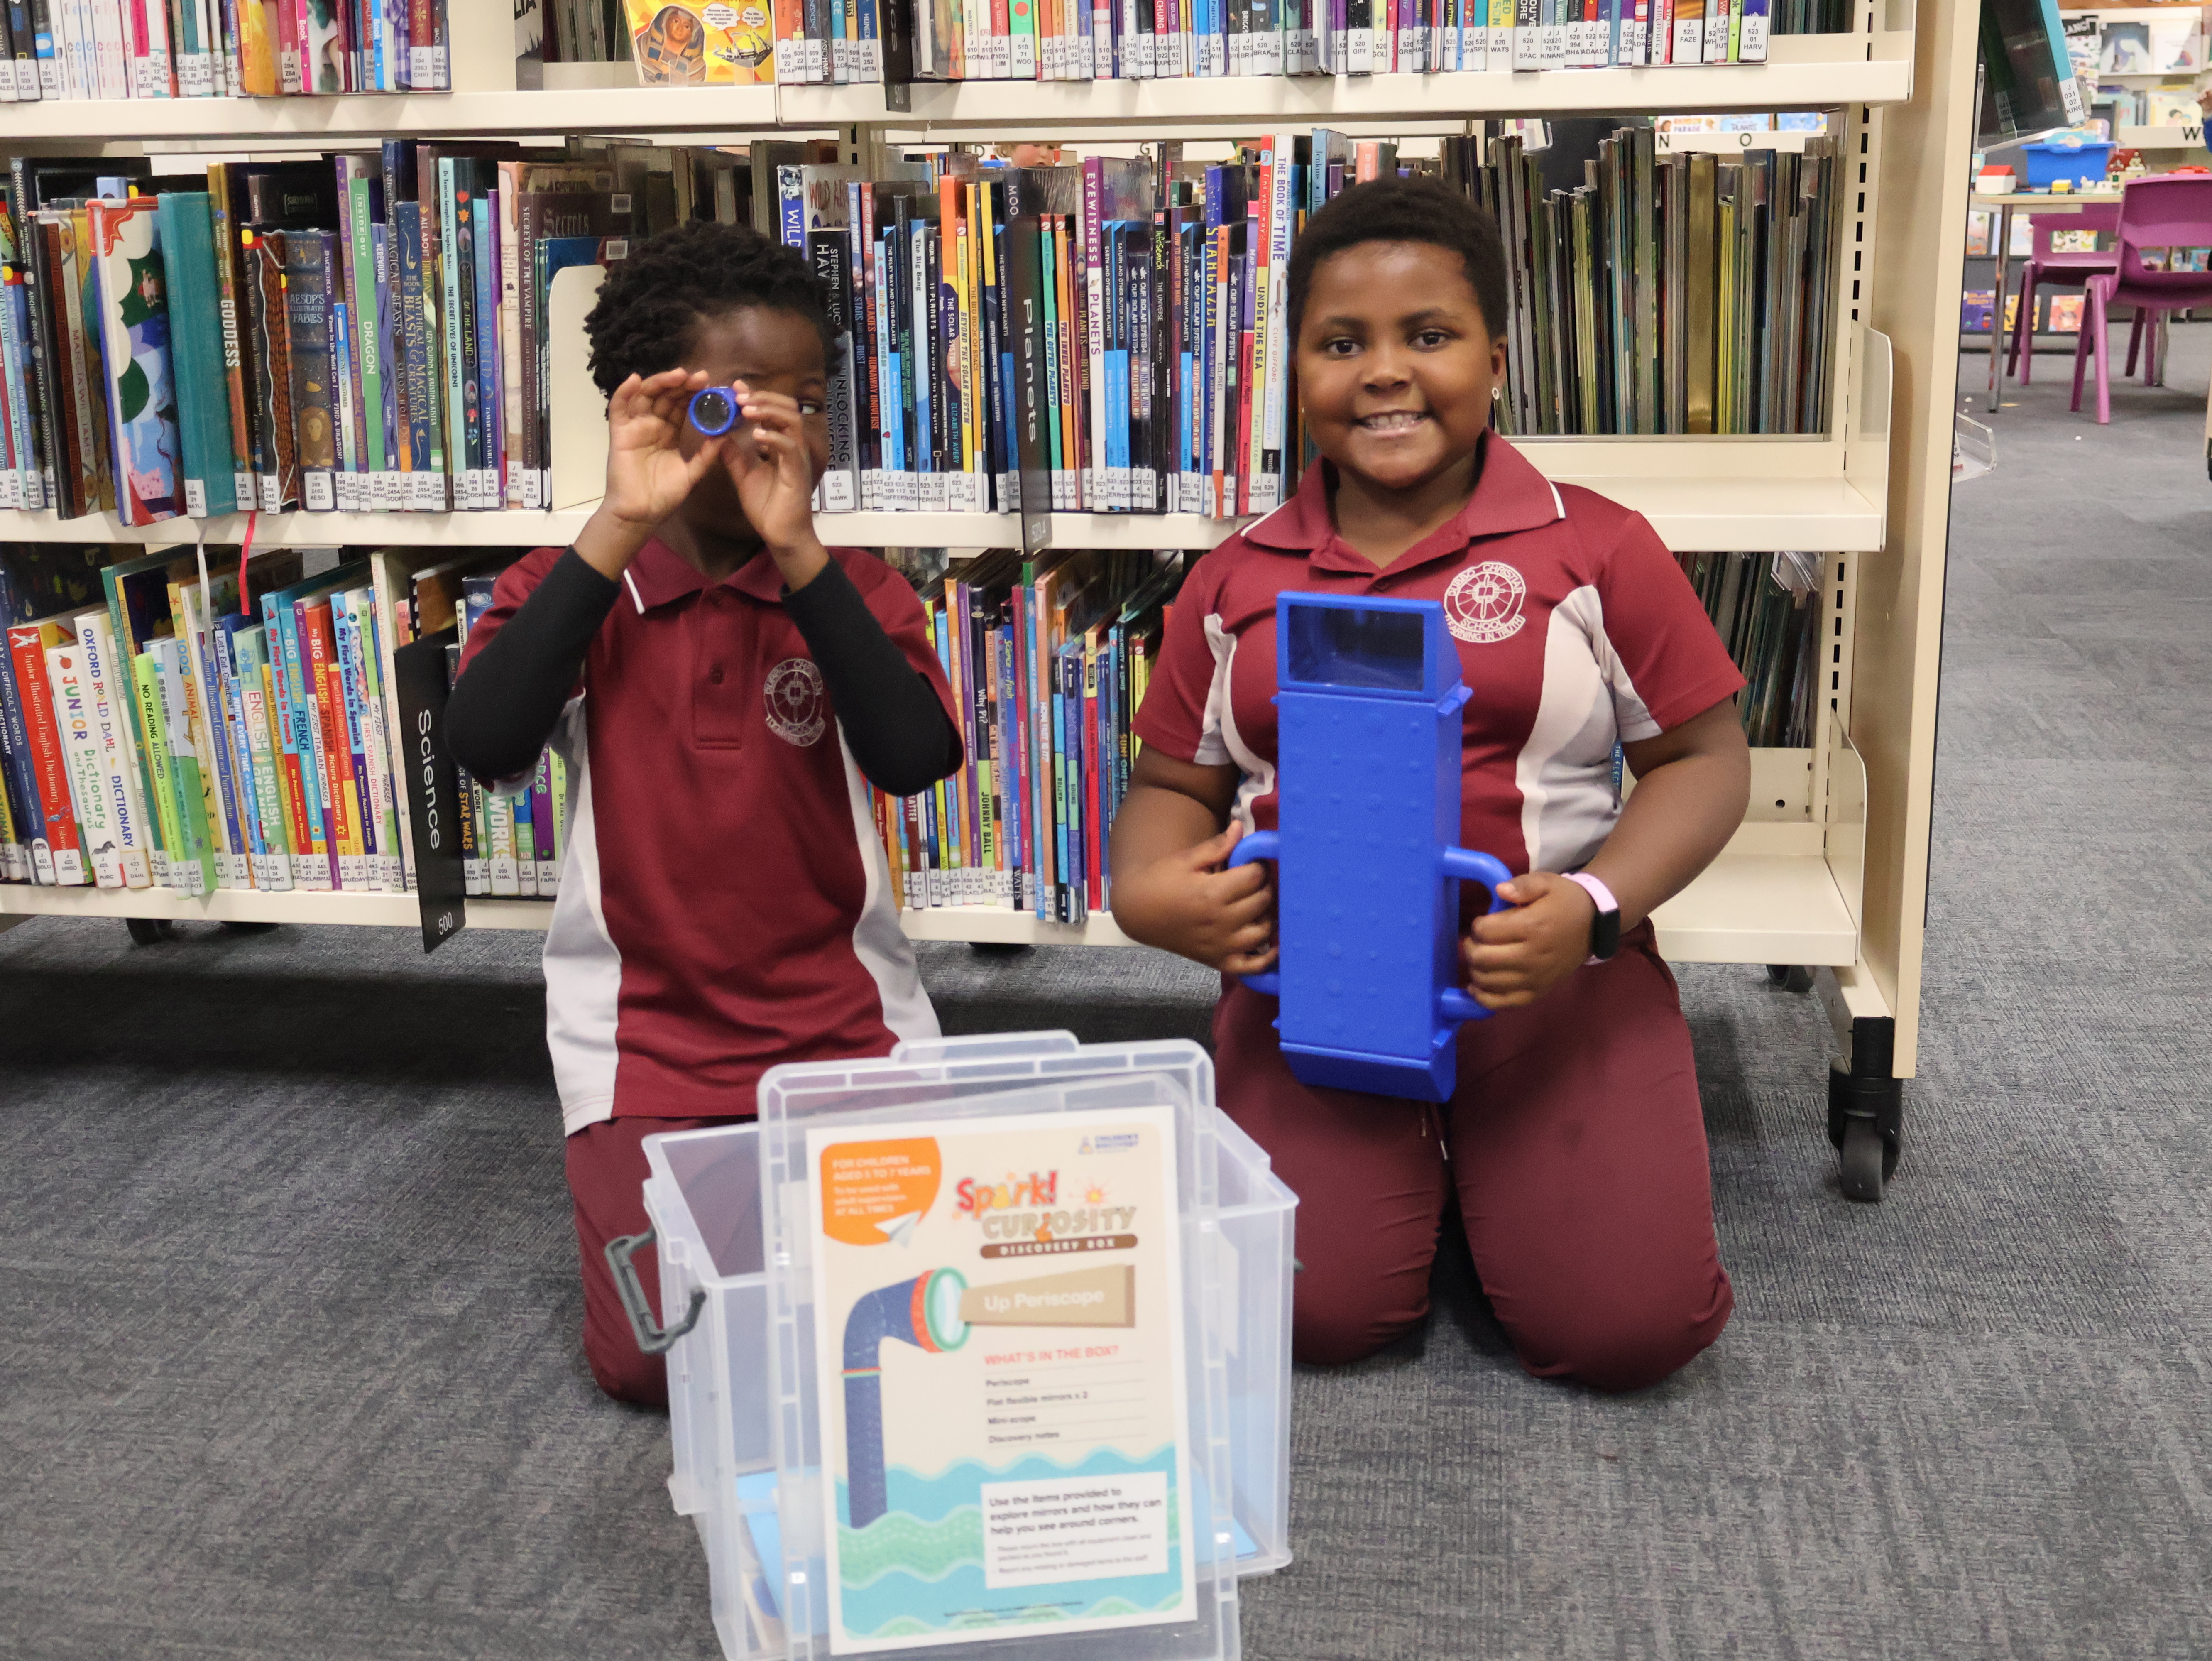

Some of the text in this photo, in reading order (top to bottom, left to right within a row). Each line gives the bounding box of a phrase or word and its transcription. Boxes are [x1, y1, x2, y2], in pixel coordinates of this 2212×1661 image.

[2066, 105, 2084, 114] KING
[1659, 134, 1669, 148] N
[1740, 133, 1752, 146] O
[2183, 127, 2201, 141] W
[1140, 143, 1150, 155] G
[1087, 172, 1098, 262] EYEWITNESS
[1272, 157, 1286, 261] THE BOOK OF TIME
[376, 243, 385, 283] WEREWOLVES
[524, 252, 530, 262] OF
[290, 294, 325, 305] AESOP'S
[1256, 287, 1265, 323] UNDER
[293, 313, 323, 323] FABLES
[1089, 293, 1101, 355] PLANETS
[221, 299, 240, 367] GODDESS
[451, 342, 457, 352] OF
[465, 329, 473, 356] LAND
[363, 321, 376, 375] DRAGON
[1255, 347, 1263, 370] SEA
[1023, 298, 1036, 443] Planets
[962, 392, 971, 424] SYSTEM
[1448, 564, 1523, 596] DUBBO CHRISTIAN
[269, 628, 277, 643] My
[1460, 617, 1506, 631] SCHOOL
[1498, 617, 1524, 638] TRUTH
[273, 646, 282, 667] First
[177, 639, 191, 676] 1000
[185, 682, 198, 720] ANIMAL
[276, 669, 286, 698] Words
[62, 676, 88, 741] JUNIOR
[976, 689, 986, 710] Why
[25, 653, 59, 803] Junior Illustrated English Dictionary
[83, 628, 101, 679] OXFORD
[100, 722, 115, 752] DAHL
[111, 775, 134, 847] DICTIONARY
[141, 684, 165, 779] NO READING ALLOWED
[233, 697, 250, 772] WRITE EVERY TIME
[282, 714, 294, 745] French
[84, 749, 105, 829] Dictionary
[418, 709, 440, 850] Science
[78, 770, 95, 829] Thesaurus
[262, 767, 280, 826] ENGLISH
[981, 792, 992, 854] JOHNNY BALL
[438, 912, 453, 936] 500
[955, 1169, 1058, 1220] Spark!
[1000, 1237, 1115, 1256] DISCOVERY BOX
[984, 1290, 1105, 1313] Up Periscope
[985, 1344, 1120, 1365] WHAT'S IN THE BOX?
[986, 1379, 1029, 1387] Periscope
[989, 1498, 1010, 1507] Use
[1032, 1494, 1060, 1503] items
[1063, 1489, 1108, 1502] provided
[990, 1511, 1028, 1521] explore
[1032, 1508, 1068, 1516] mirrors
[1071, 1505, 1091, 1514] and
[1093, 1503, 1115, 1512] how
[1118, 1501, 1140, 1510] they
[991, 1526, 1014, 1535] help
[1017, 1525, 1035, 1536] you
[1059, 1518, 1095, 1529] around
